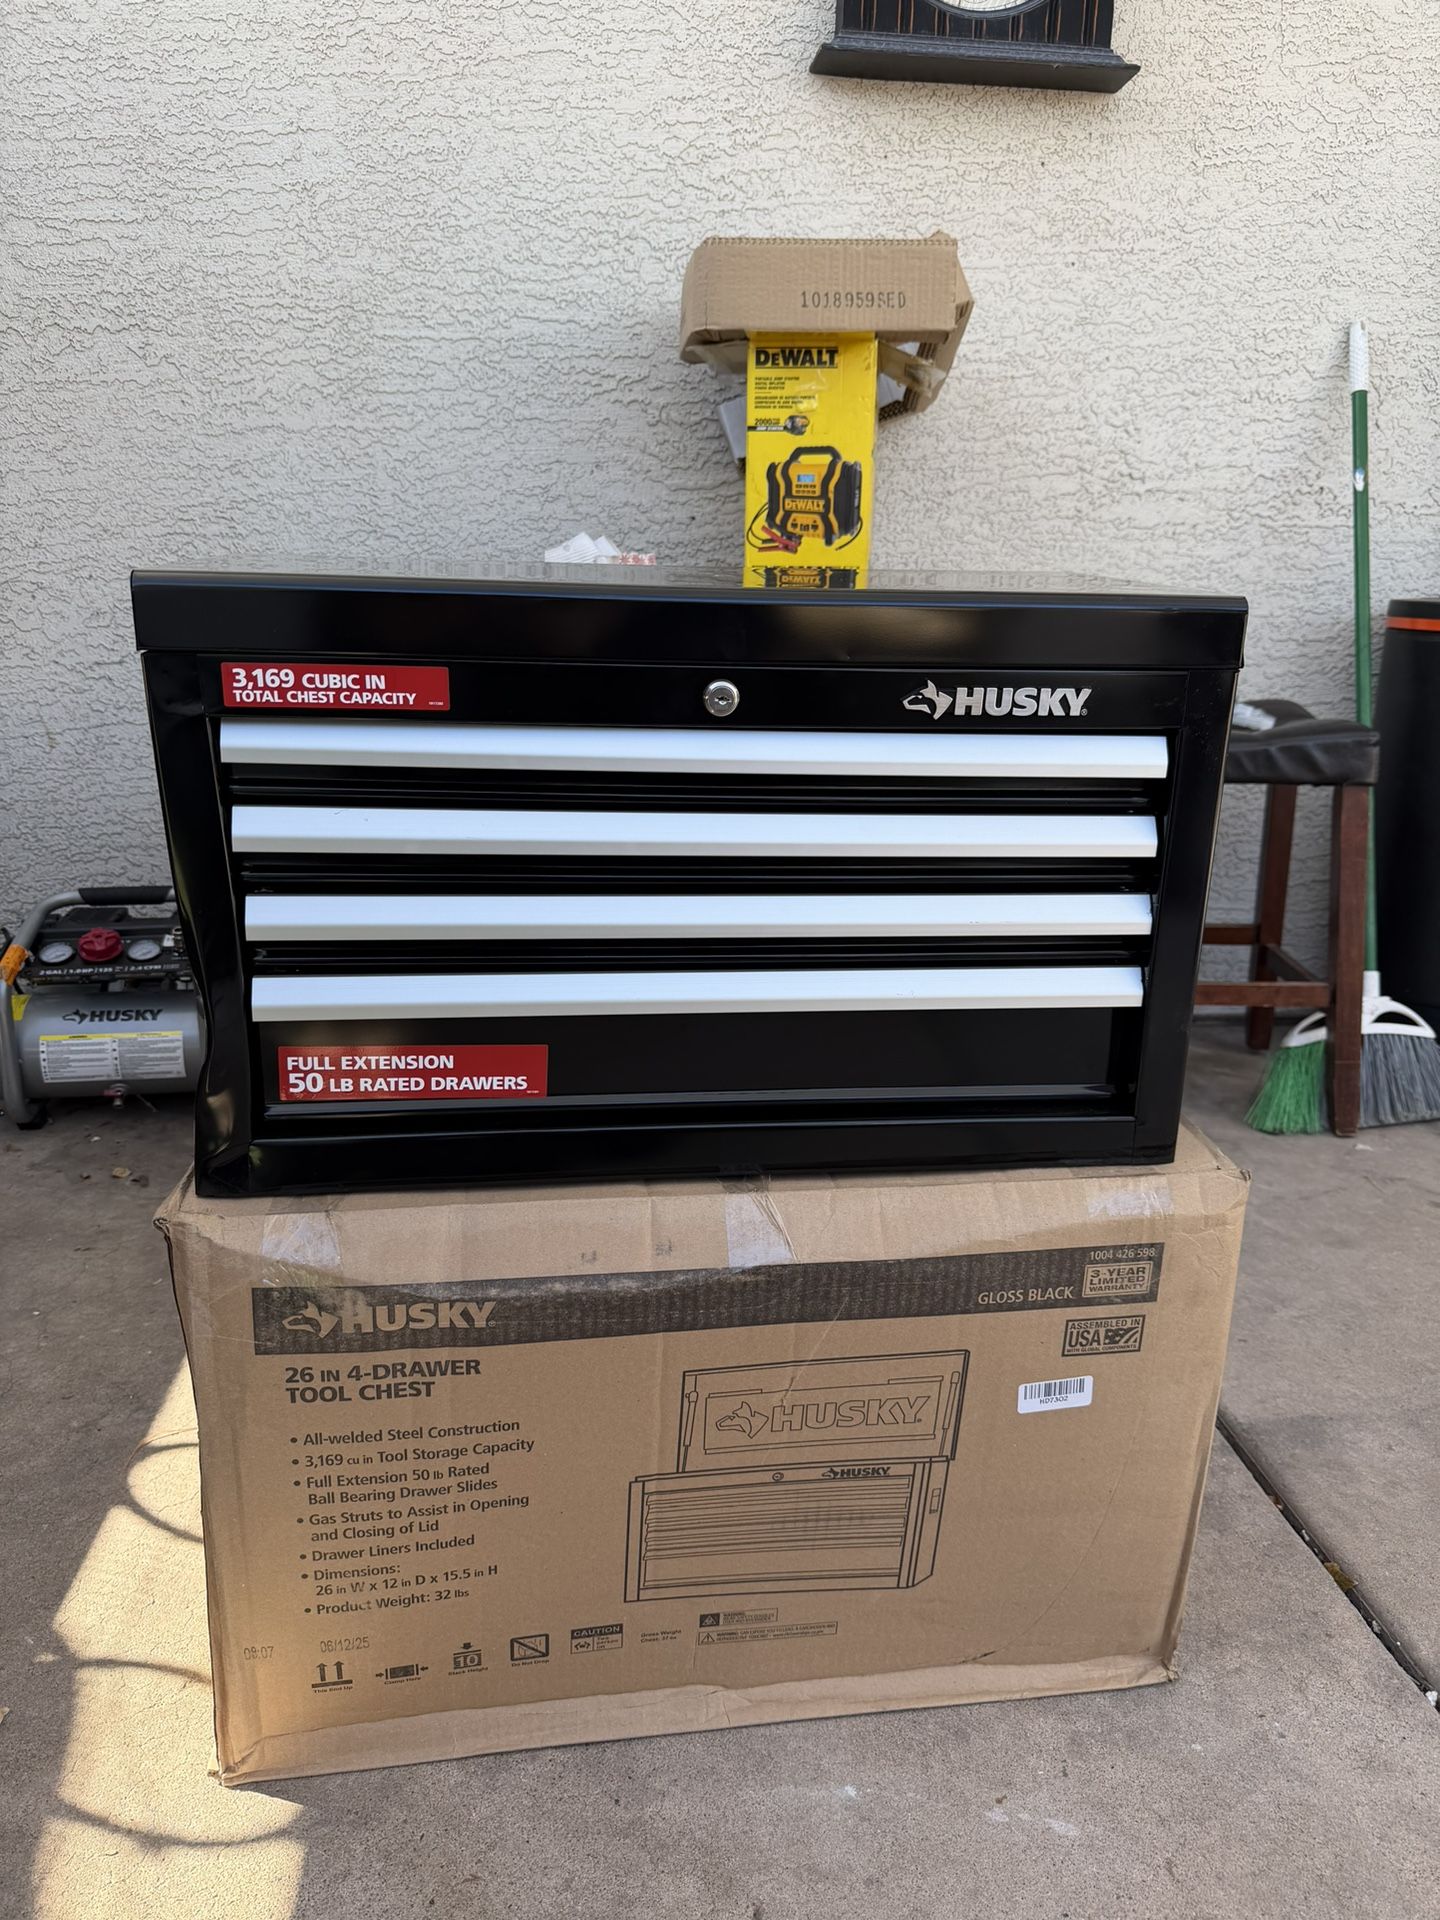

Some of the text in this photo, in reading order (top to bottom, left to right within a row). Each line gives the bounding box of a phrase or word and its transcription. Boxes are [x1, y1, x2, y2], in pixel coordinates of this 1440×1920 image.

[232, 668, 386, 690] 3,169 CUBIC IN
[233, 690, 416, 705] TOTAL CHEST CAPACITY
[954, 687, 1093, 716] HUSKY
[89, 1008, 163, 1022] HUSKY
[287, 1055, 454, 1071] FULL EXTENSION
[289, 1073, 527, 1093] 50 LB RATED DRAWERS
[1089, 1250, 1113, 1261] 1004
[1137, 1247, 1156, 1258] 598
[1089, 1275, 1146, 1286] LIMITED
[1090, 1266, 1146, 1279] 3-YEAR
[978, 1286, 1074, 1304] GLOSS BLACK
[1088, 1284, 1145, 1292] WARRANTY
[342, 1291, 496, 1333] HUSKY
[1069, 1318, 1141, 1330] ASSEMBLED IN
[1068, 1329, 1101, 1347] USA
[285, 1359, 481, 1383] 26 IN 4-DRAWER
[286, 1381, 435, 1403] TOOL CHEST
[771, 1396, 931, 1432] HUSKY
[303, 1420, 520, 1446] All-welded Steel Construction
[305, 1439, 535, 1468] 3,169 cu in Tool Storage Capacity
[306, 1463, 490, 1488] Full Extension 50 lb Rated
[840, 1466, 891, 1478] HUSKY
[308, 1479, 498, 1505] Ball Bearing Drawer Slides
[309, 1495, 529, 1526] Gas Struts to Assist in Opening
[311, 1520, 439, 1542] and Closing of Lid
[312, 1534, 475, 1562] Drawer Liners Included
[314, 1565, 401, 1581] Dimensions:
[316, 1565, 498, 1596] 26 in W x 12 in D x 15.5 in H
[316, 1589, 469, 1615] Product Weight: 32 lbs
[574, 1625, 620, 1637] CAUTION
[455, 1654, 478, 1668] 10
